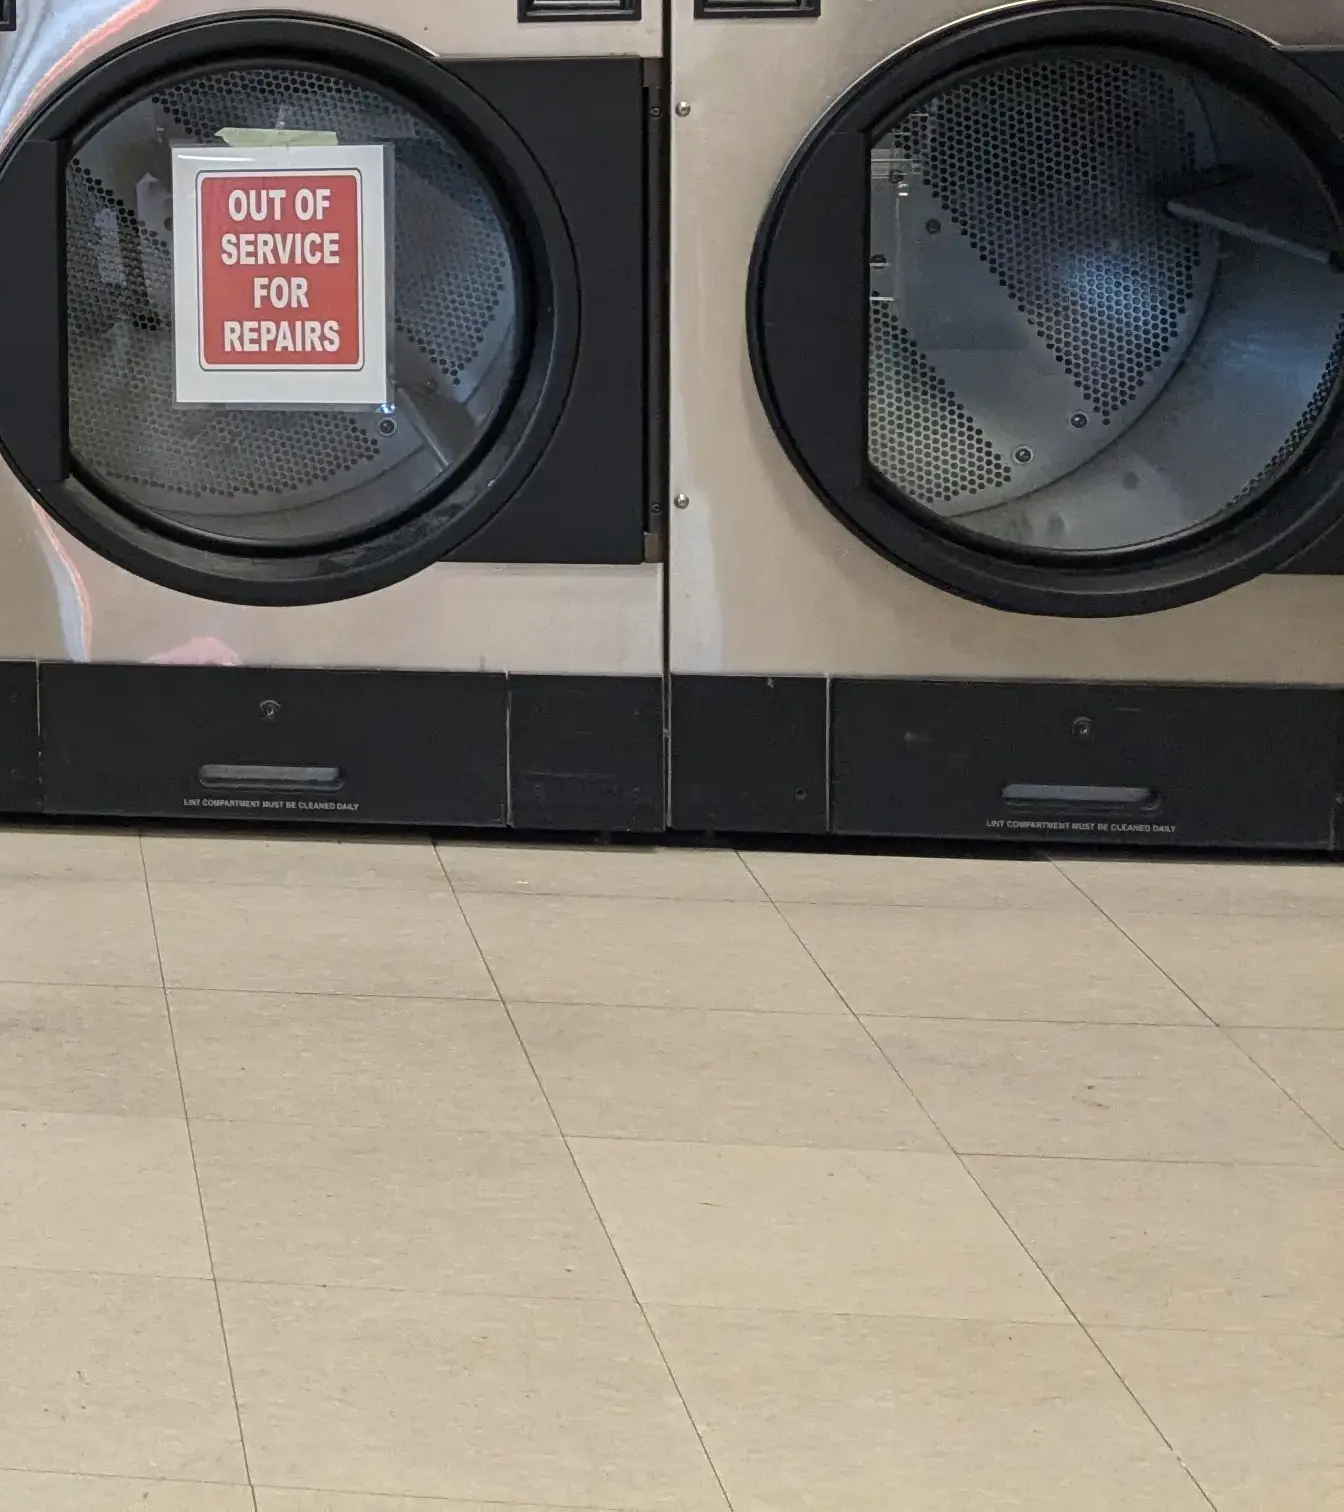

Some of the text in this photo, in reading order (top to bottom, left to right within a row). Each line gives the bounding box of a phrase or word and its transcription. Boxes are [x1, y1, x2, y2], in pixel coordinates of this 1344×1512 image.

[229, 188, 330, 221] OUT OF
[221, 233, 340, 265] SERVICE
[253, 277, 309, 308] FOR
[224, 320, 340, 352] REPAIRS
[202, 799, 260, 807] COMPARTMENT
[1006, 821, 1070, 829] COMPARTMENT
